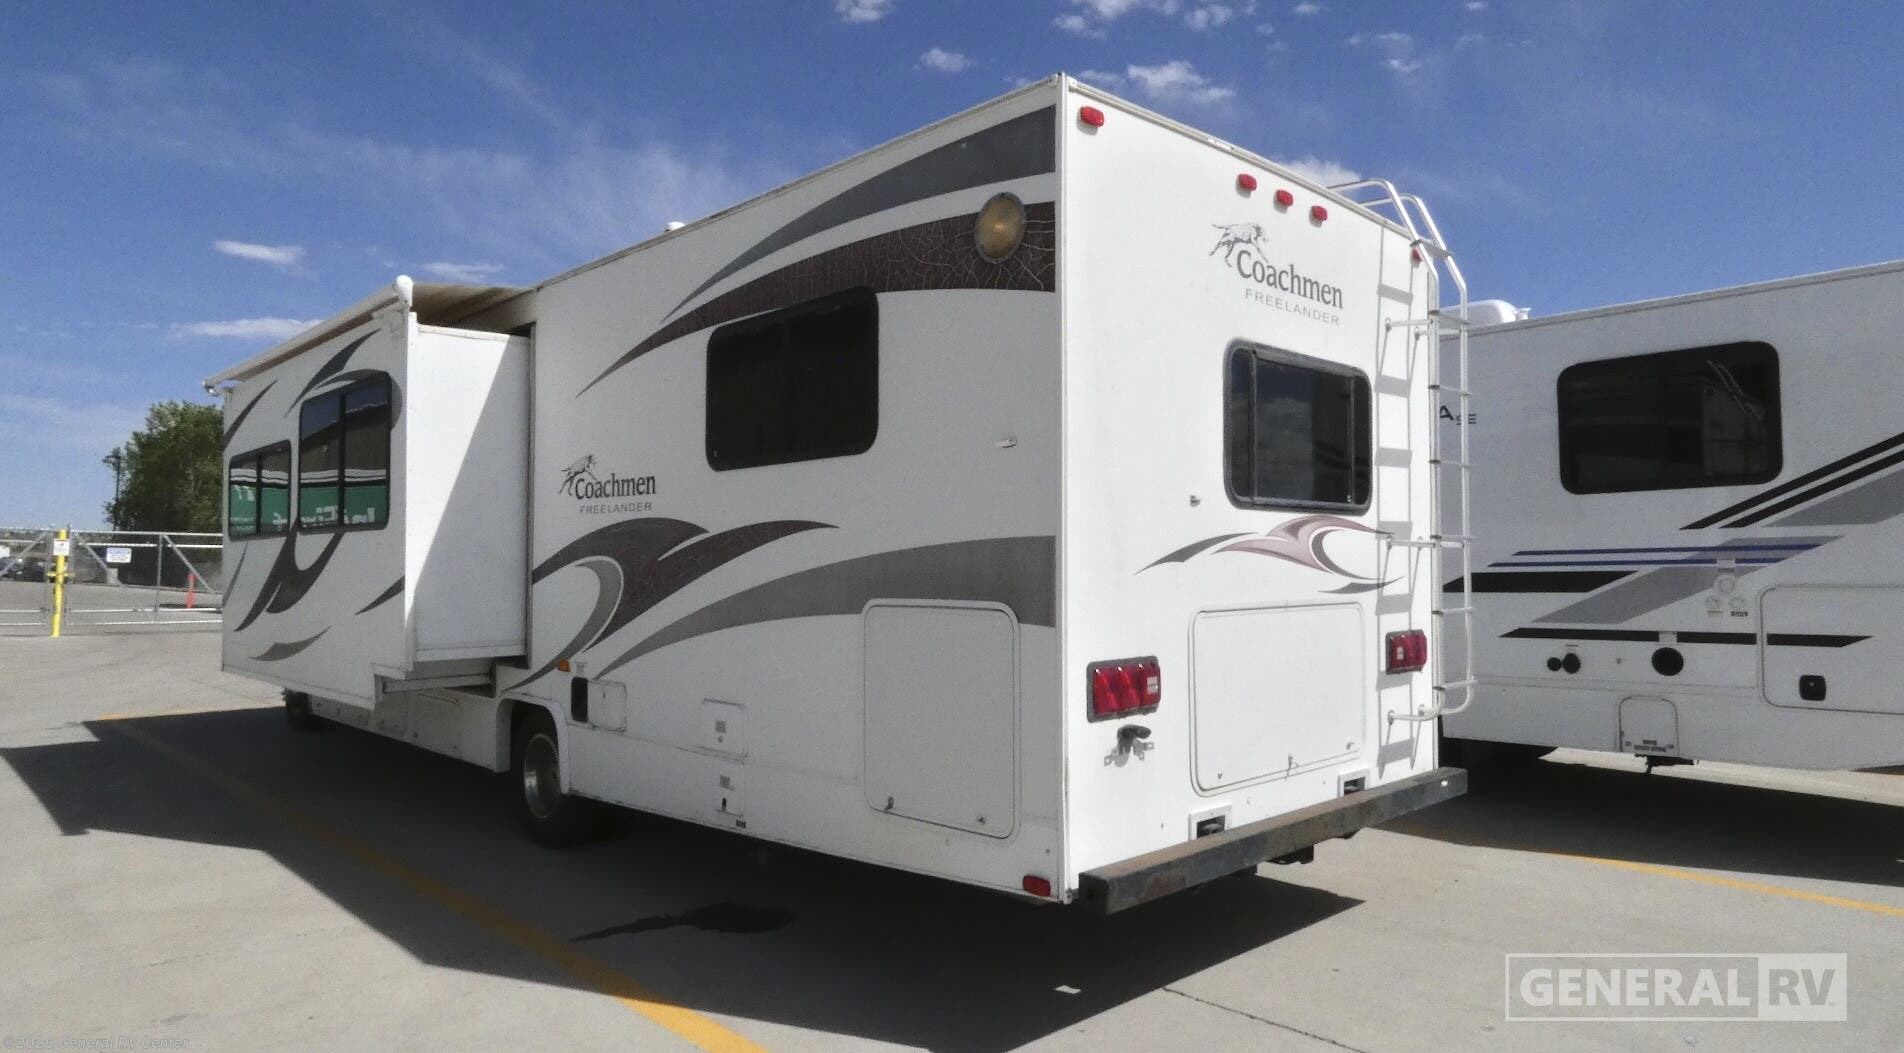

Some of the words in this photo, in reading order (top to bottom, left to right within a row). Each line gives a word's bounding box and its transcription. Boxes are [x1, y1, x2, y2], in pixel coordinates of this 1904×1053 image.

[1237, 250, 1343, 309] Coachmen
[1245, 288, 1340, 326] FREELANDER
[575, 472, 656, 500] Coachmen
[580, 502, 653, 514] FREELANDER
